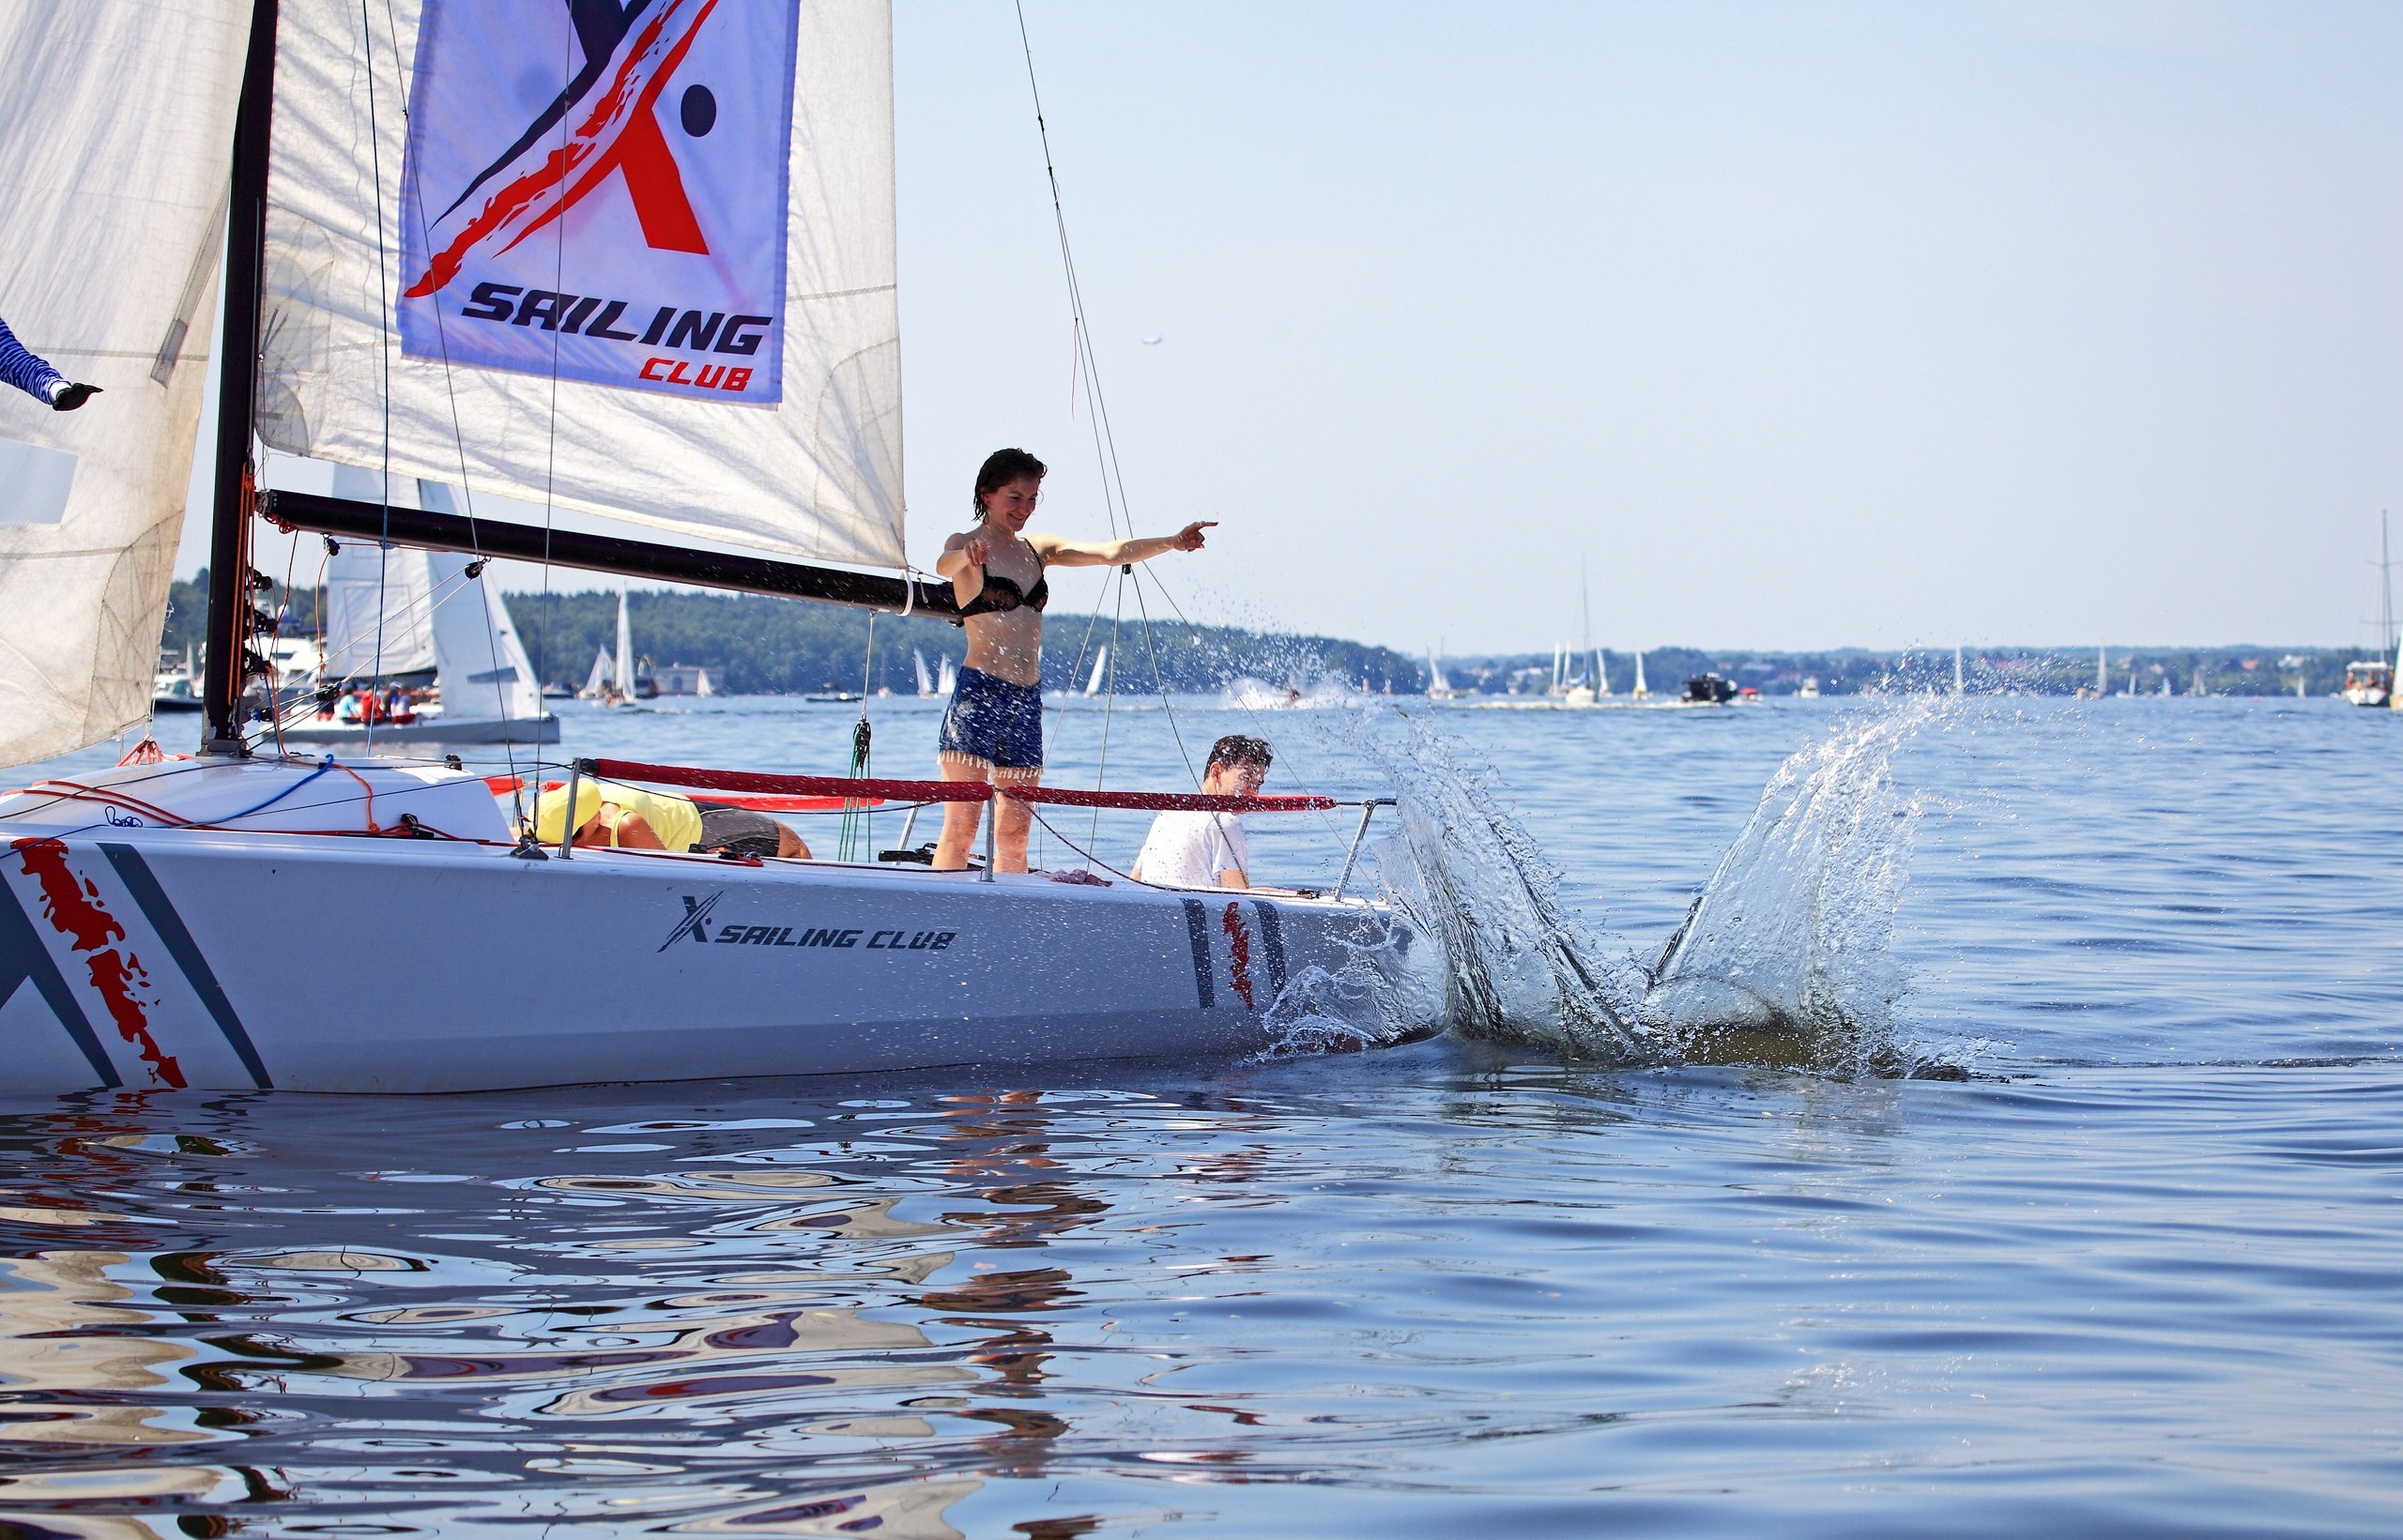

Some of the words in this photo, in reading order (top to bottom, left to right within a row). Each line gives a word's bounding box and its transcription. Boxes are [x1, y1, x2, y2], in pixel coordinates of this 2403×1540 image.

[461, 282, 773, 356] SAILING
[638, 357, 754, 391] CLUB
[714, 924, 864, 949] SAILING
[865, 930, 957, 951] CLUB
